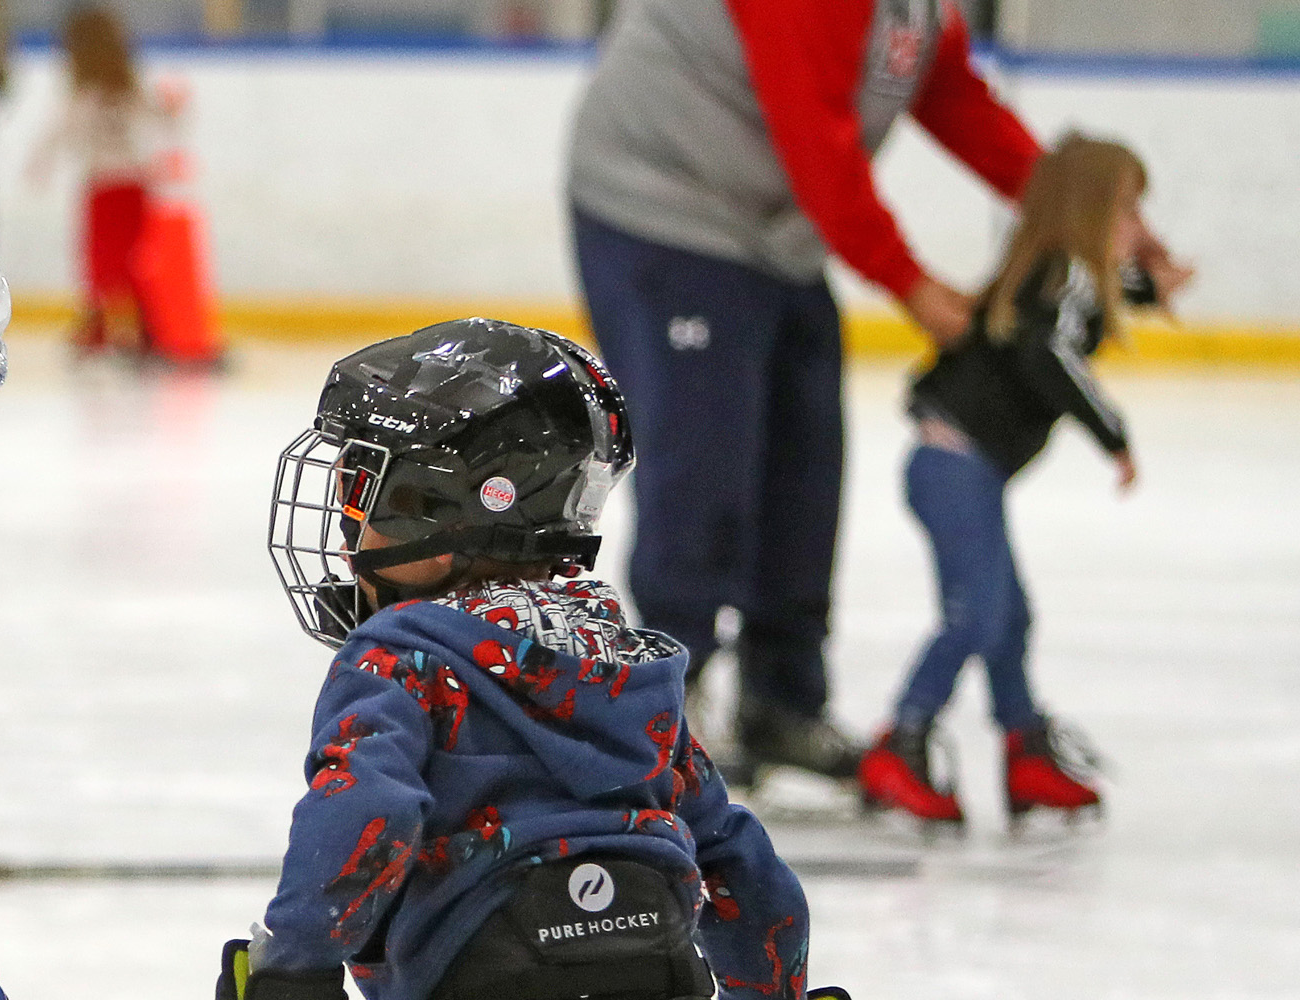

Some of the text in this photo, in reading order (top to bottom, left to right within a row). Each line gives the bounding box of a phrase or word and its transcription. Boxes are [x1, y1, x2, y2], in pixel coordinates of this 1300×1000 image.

[368, 412, 417, 434] CCM
[538, 911, 660, 943] PURE HOCKEY
